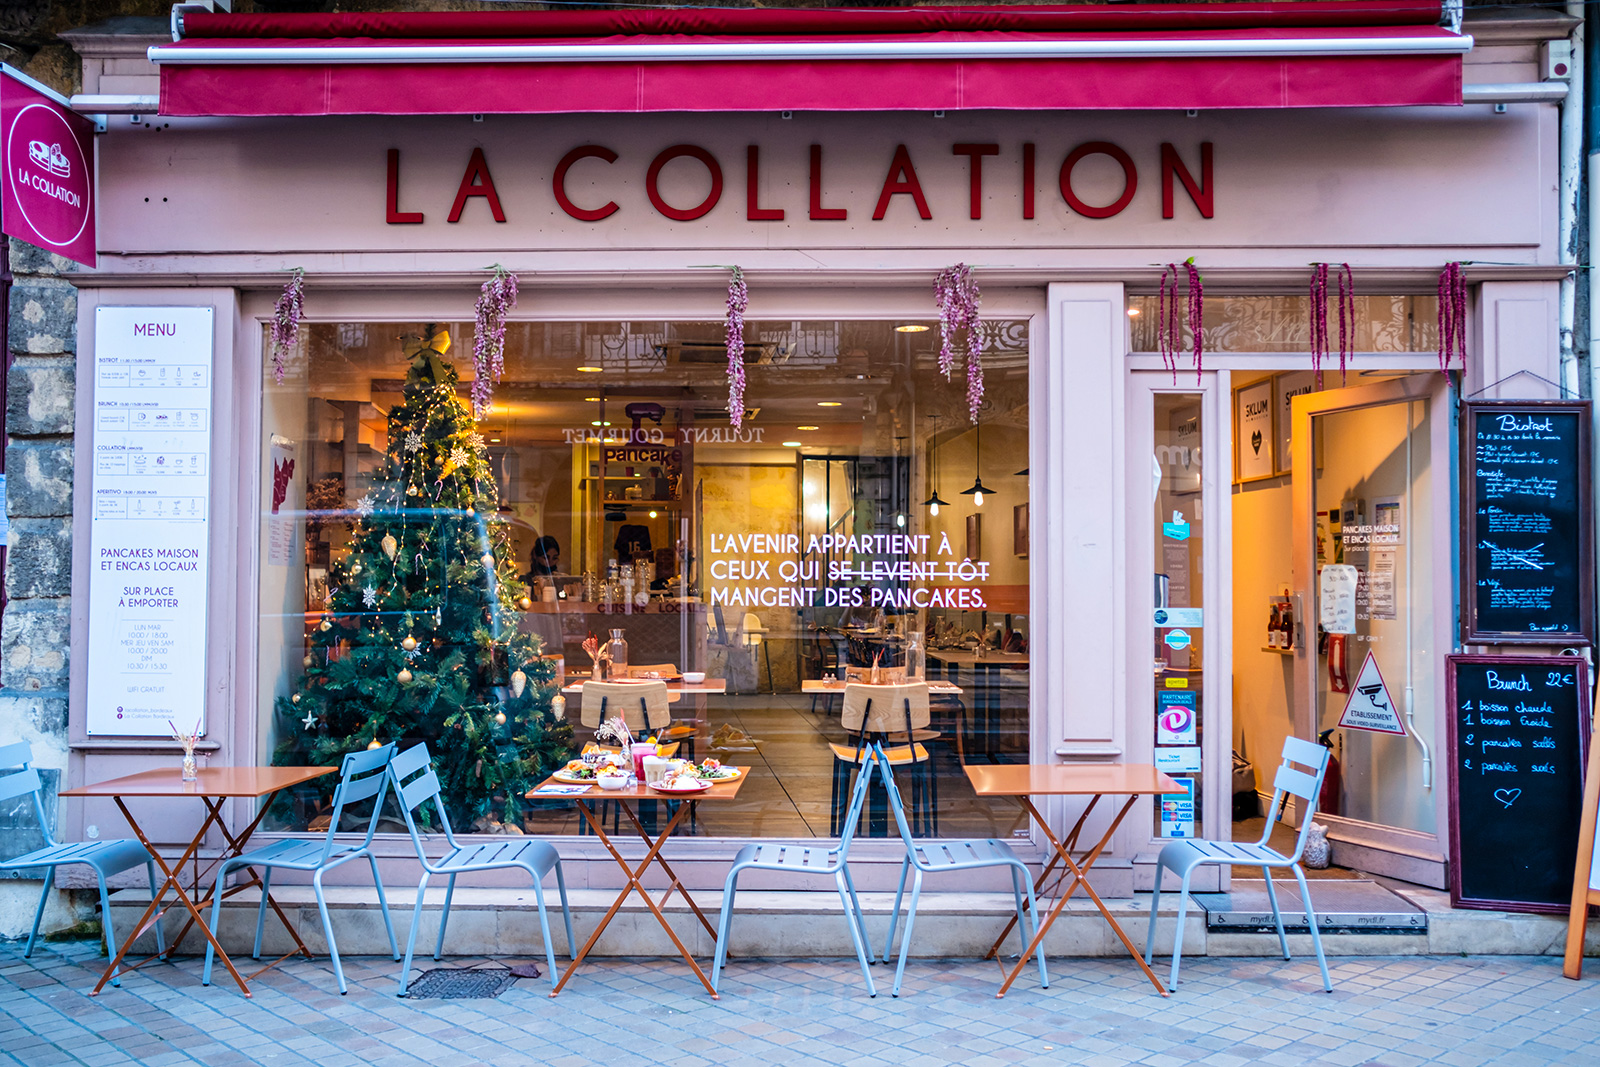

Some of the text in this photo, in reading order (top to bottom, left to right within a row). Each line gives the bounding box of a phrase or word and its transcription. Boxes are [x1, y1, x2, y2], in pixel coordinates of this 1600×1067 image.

[18, 168, 80, 208] LA COLLATION
[386, 141, 1215, 224] LA COLLATION
[134, 323, 176, 336] MENU
[1246, 399, 1268, 418] SKLUM
[1496, 414, 1553, 432] Bistrot
[1343, 524, 1398, 534] PANCAKES MAISON
[710, 531, 952, 555] L'AVENIR APPARTIENT À
[1343, 535, 1398, 544] ET ENCAS LOCAUX
[101, 548, 199, 558] PANCAKES MAISON
[101, 561, 198, 571] ET ENCAS LOCAUX
[710, 558, 990, 583] CEUX QUI SE LEVENT TÔT
[123, 587, 174, 596] SUR PLACE
[710, 587, 987, 608] MANGENT DES PANCAKES.
[119, 597, 178, 608] À EMPORTER
[1486, 670, 1574, 691] Brunch 22€
[1461, 700, 1473, 710] 1
[1480, 700, 1509, 712] boisson
[1351, 710, 1392, 721] ETABLISSEMENT
[1463, 714, 1474, 725] 1
[1480, 713, 1511, 726] boisson
[1465, 734, 1474, 746] 2
[1464, 759, 1473, 769] 2
